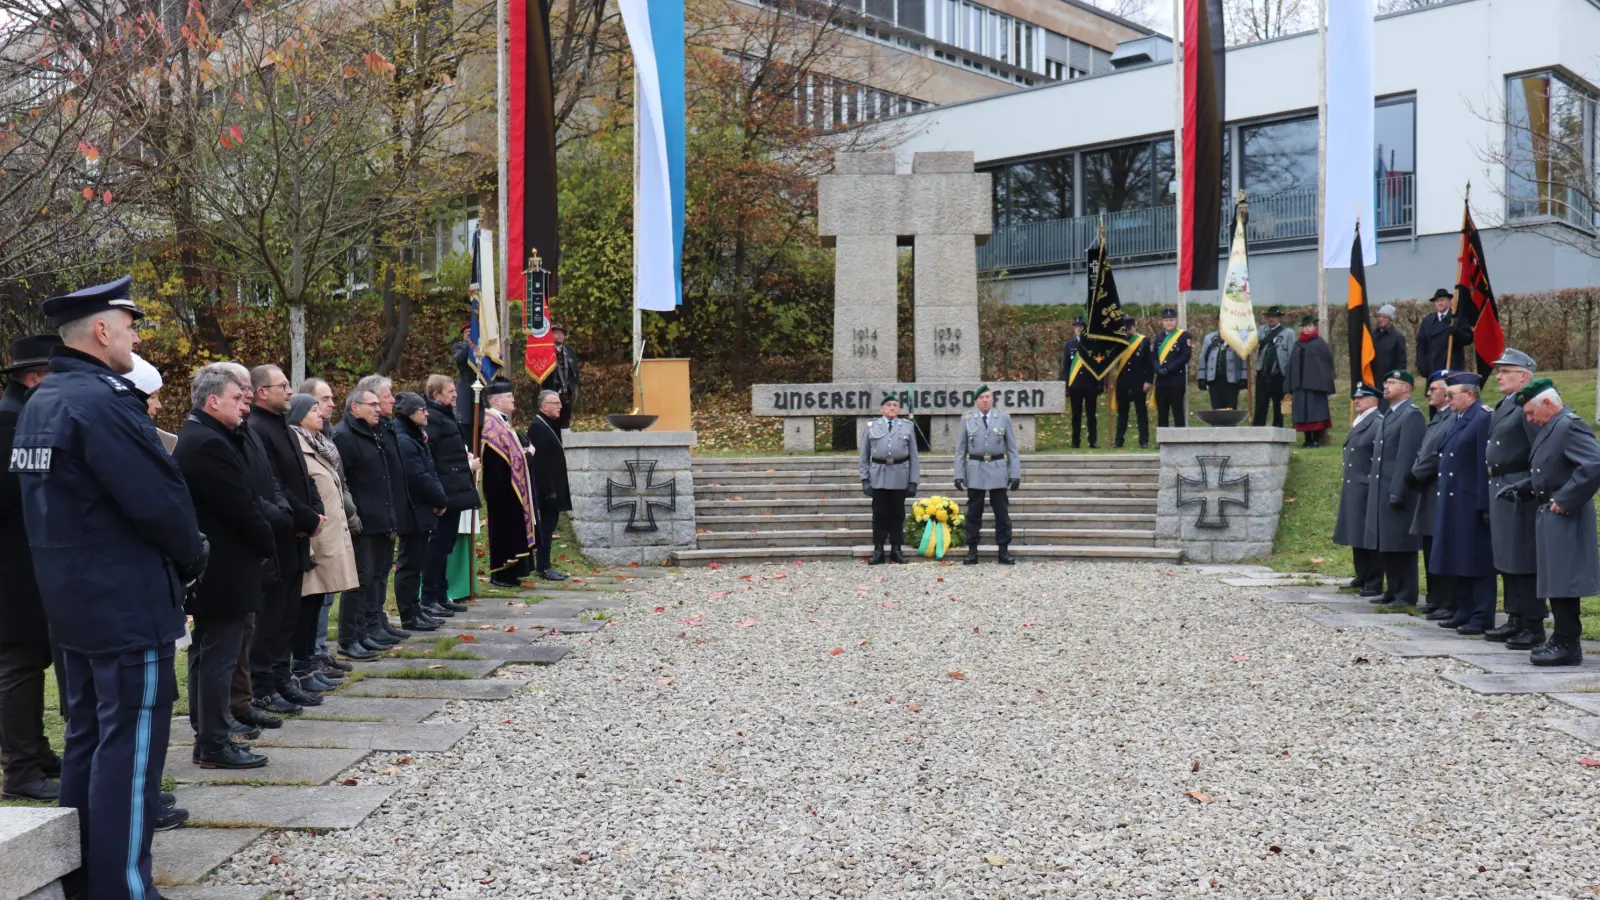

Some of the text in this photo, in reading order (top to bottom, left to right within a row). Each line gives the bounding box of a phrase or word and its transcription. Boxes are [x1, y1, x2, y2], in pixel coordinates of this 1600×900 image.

[852, 327, 878, 343] 1914
[934, 327, 962, 341] 1939
[852, 344, 878, 358] 1918
[934, 342, 961, 357] 1945
[774, 389, 1044, 410] UNSEREN RIEGSOFERN
